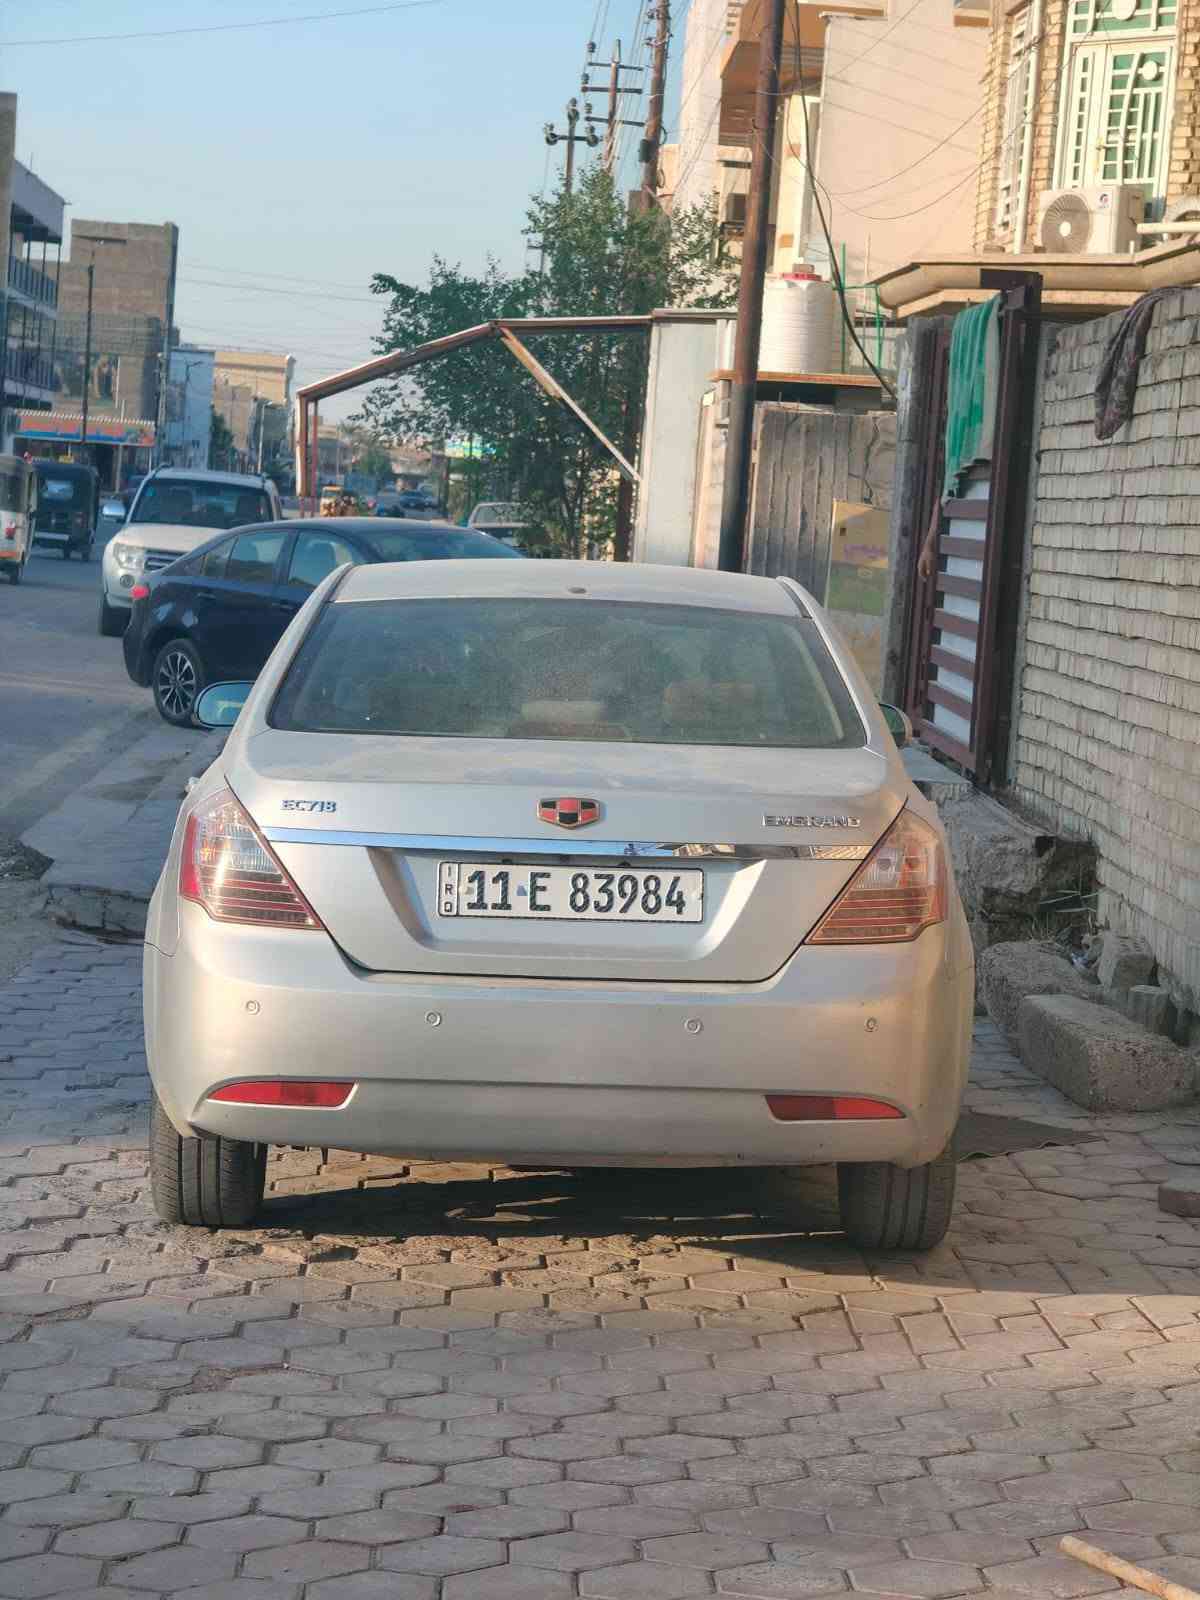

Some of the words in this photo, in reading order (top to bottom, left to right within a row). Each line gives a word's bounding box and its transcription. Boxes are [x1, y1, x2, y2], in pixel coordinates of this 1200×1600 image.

[466, 870, 513, 911] 11
[528, 871, 553, 912] E
[568, 872, 687, 916] 83984
